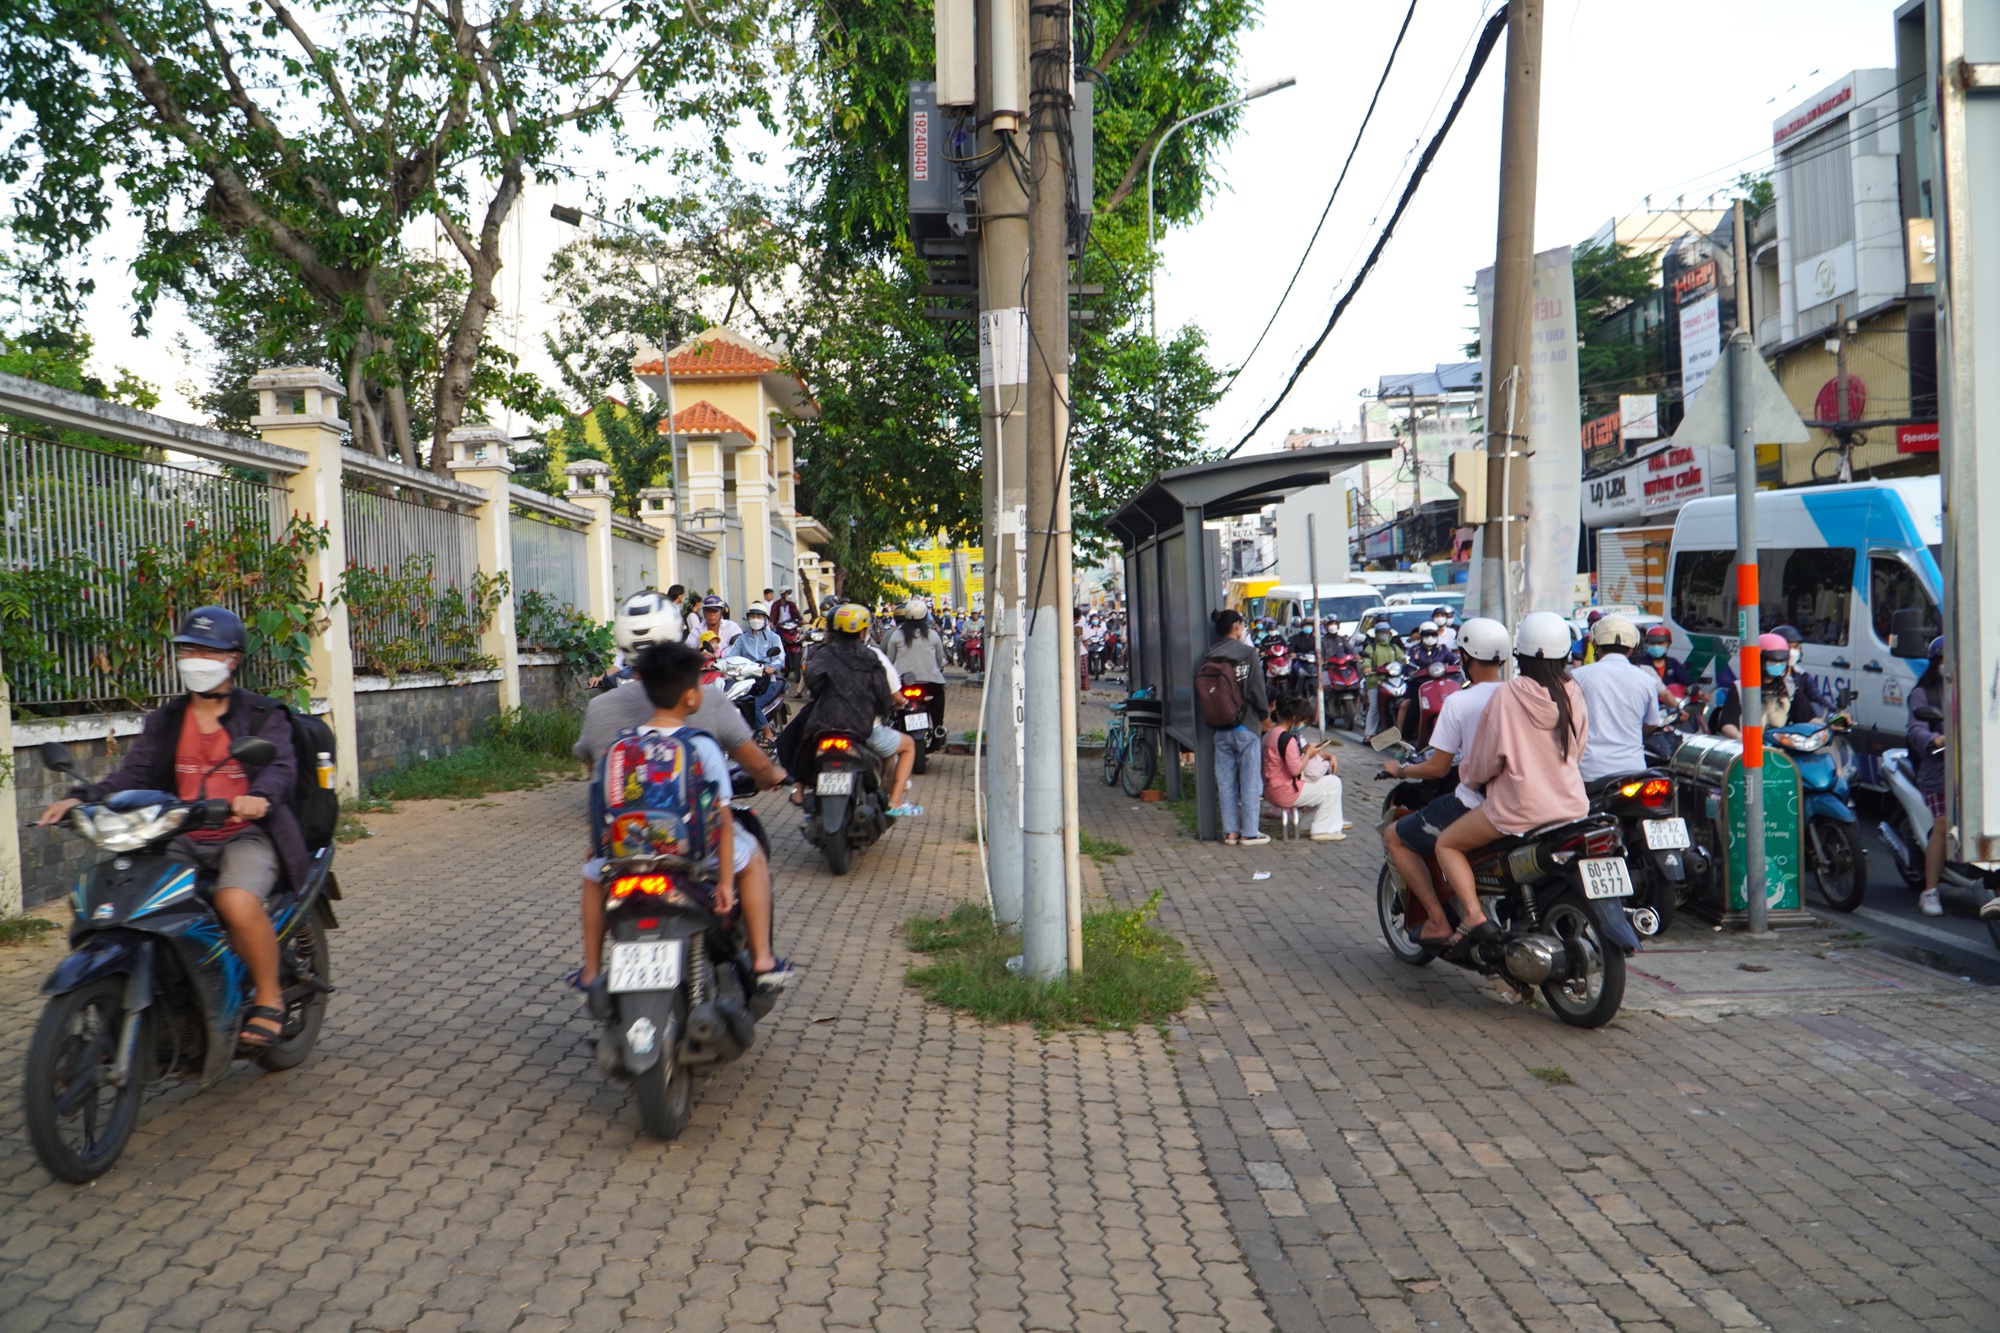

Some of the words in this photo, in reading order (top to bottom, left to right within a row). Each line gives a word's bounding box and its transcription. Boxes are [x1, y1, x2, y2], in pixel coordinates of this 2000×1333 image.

[914, 112, 927, 180] 192400401
[1902, 432, 1940, 444] Reebo
[1648, 453, 1667, 473] NHA
[1669, 446, 1695, 467] KHOA
[1590, 482, 1604, 508] LỌ
[1605, 475, 1627, 499] LEM
[1650, 821, 1680, 834] 59-X2
[1587, 861, 1621, 878] 60-P1
[1591, 877, 1624, 895] 8577
